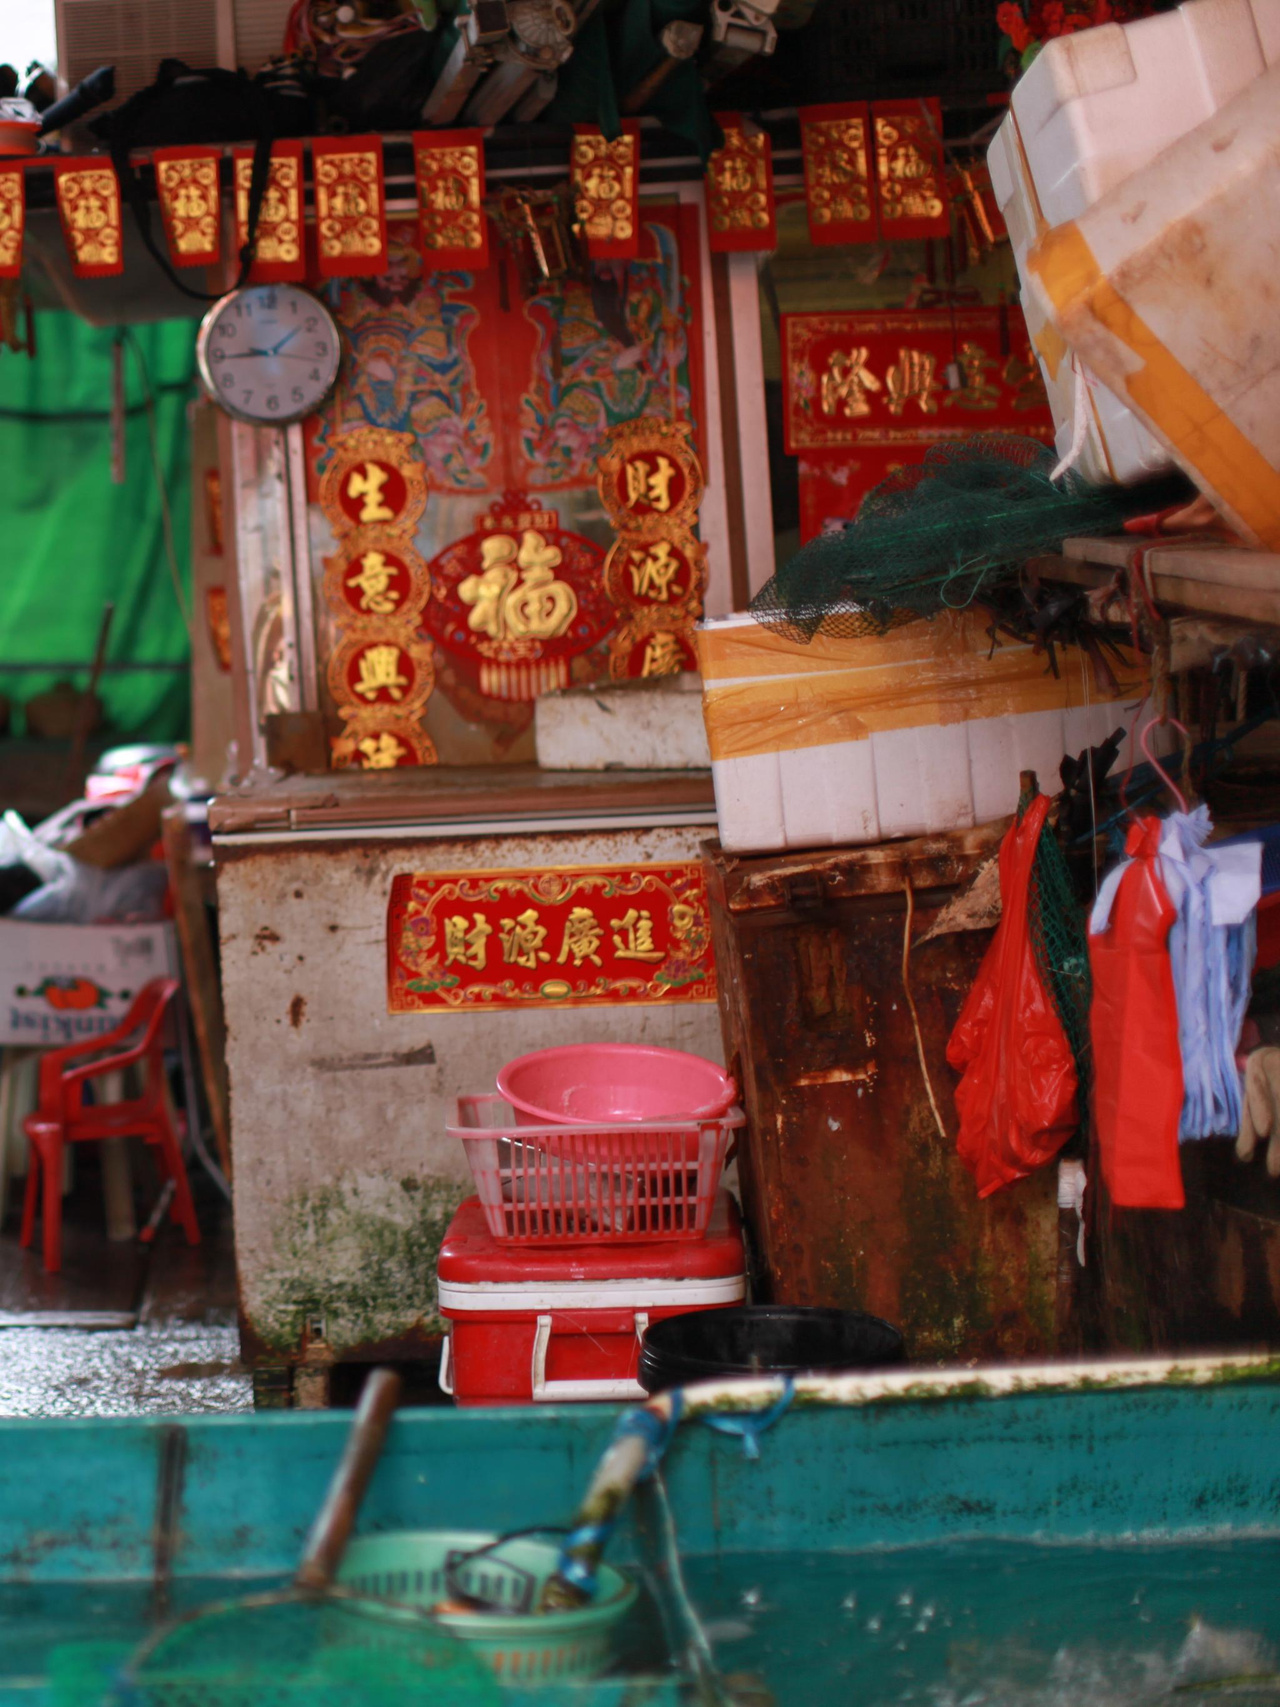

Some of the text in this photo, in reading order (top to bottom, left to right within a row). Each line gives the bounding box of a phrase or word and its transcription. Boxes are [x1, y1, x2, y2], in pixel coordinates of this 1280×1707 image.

[584, 165, 620, 198] 福
[720, 158, 751, 191] 福
[172, 186, 208, 218] 福
[331, 184, 367, 216] 福
[431, 177, 465, 210] 福
[74, 198, 108, 229] 福
[305, 316, 319, 333] 2
[315, 341, 328, 357] 3
[243, 389, 254, 404] 7
[266, 394, 279, 411] 6
[291, 386, 304, 403] 5
[457, 529, 579, 641] 福
[443, 906, 667, 971] 財源廣進
[10, 1007, 122, 1040] unkist
